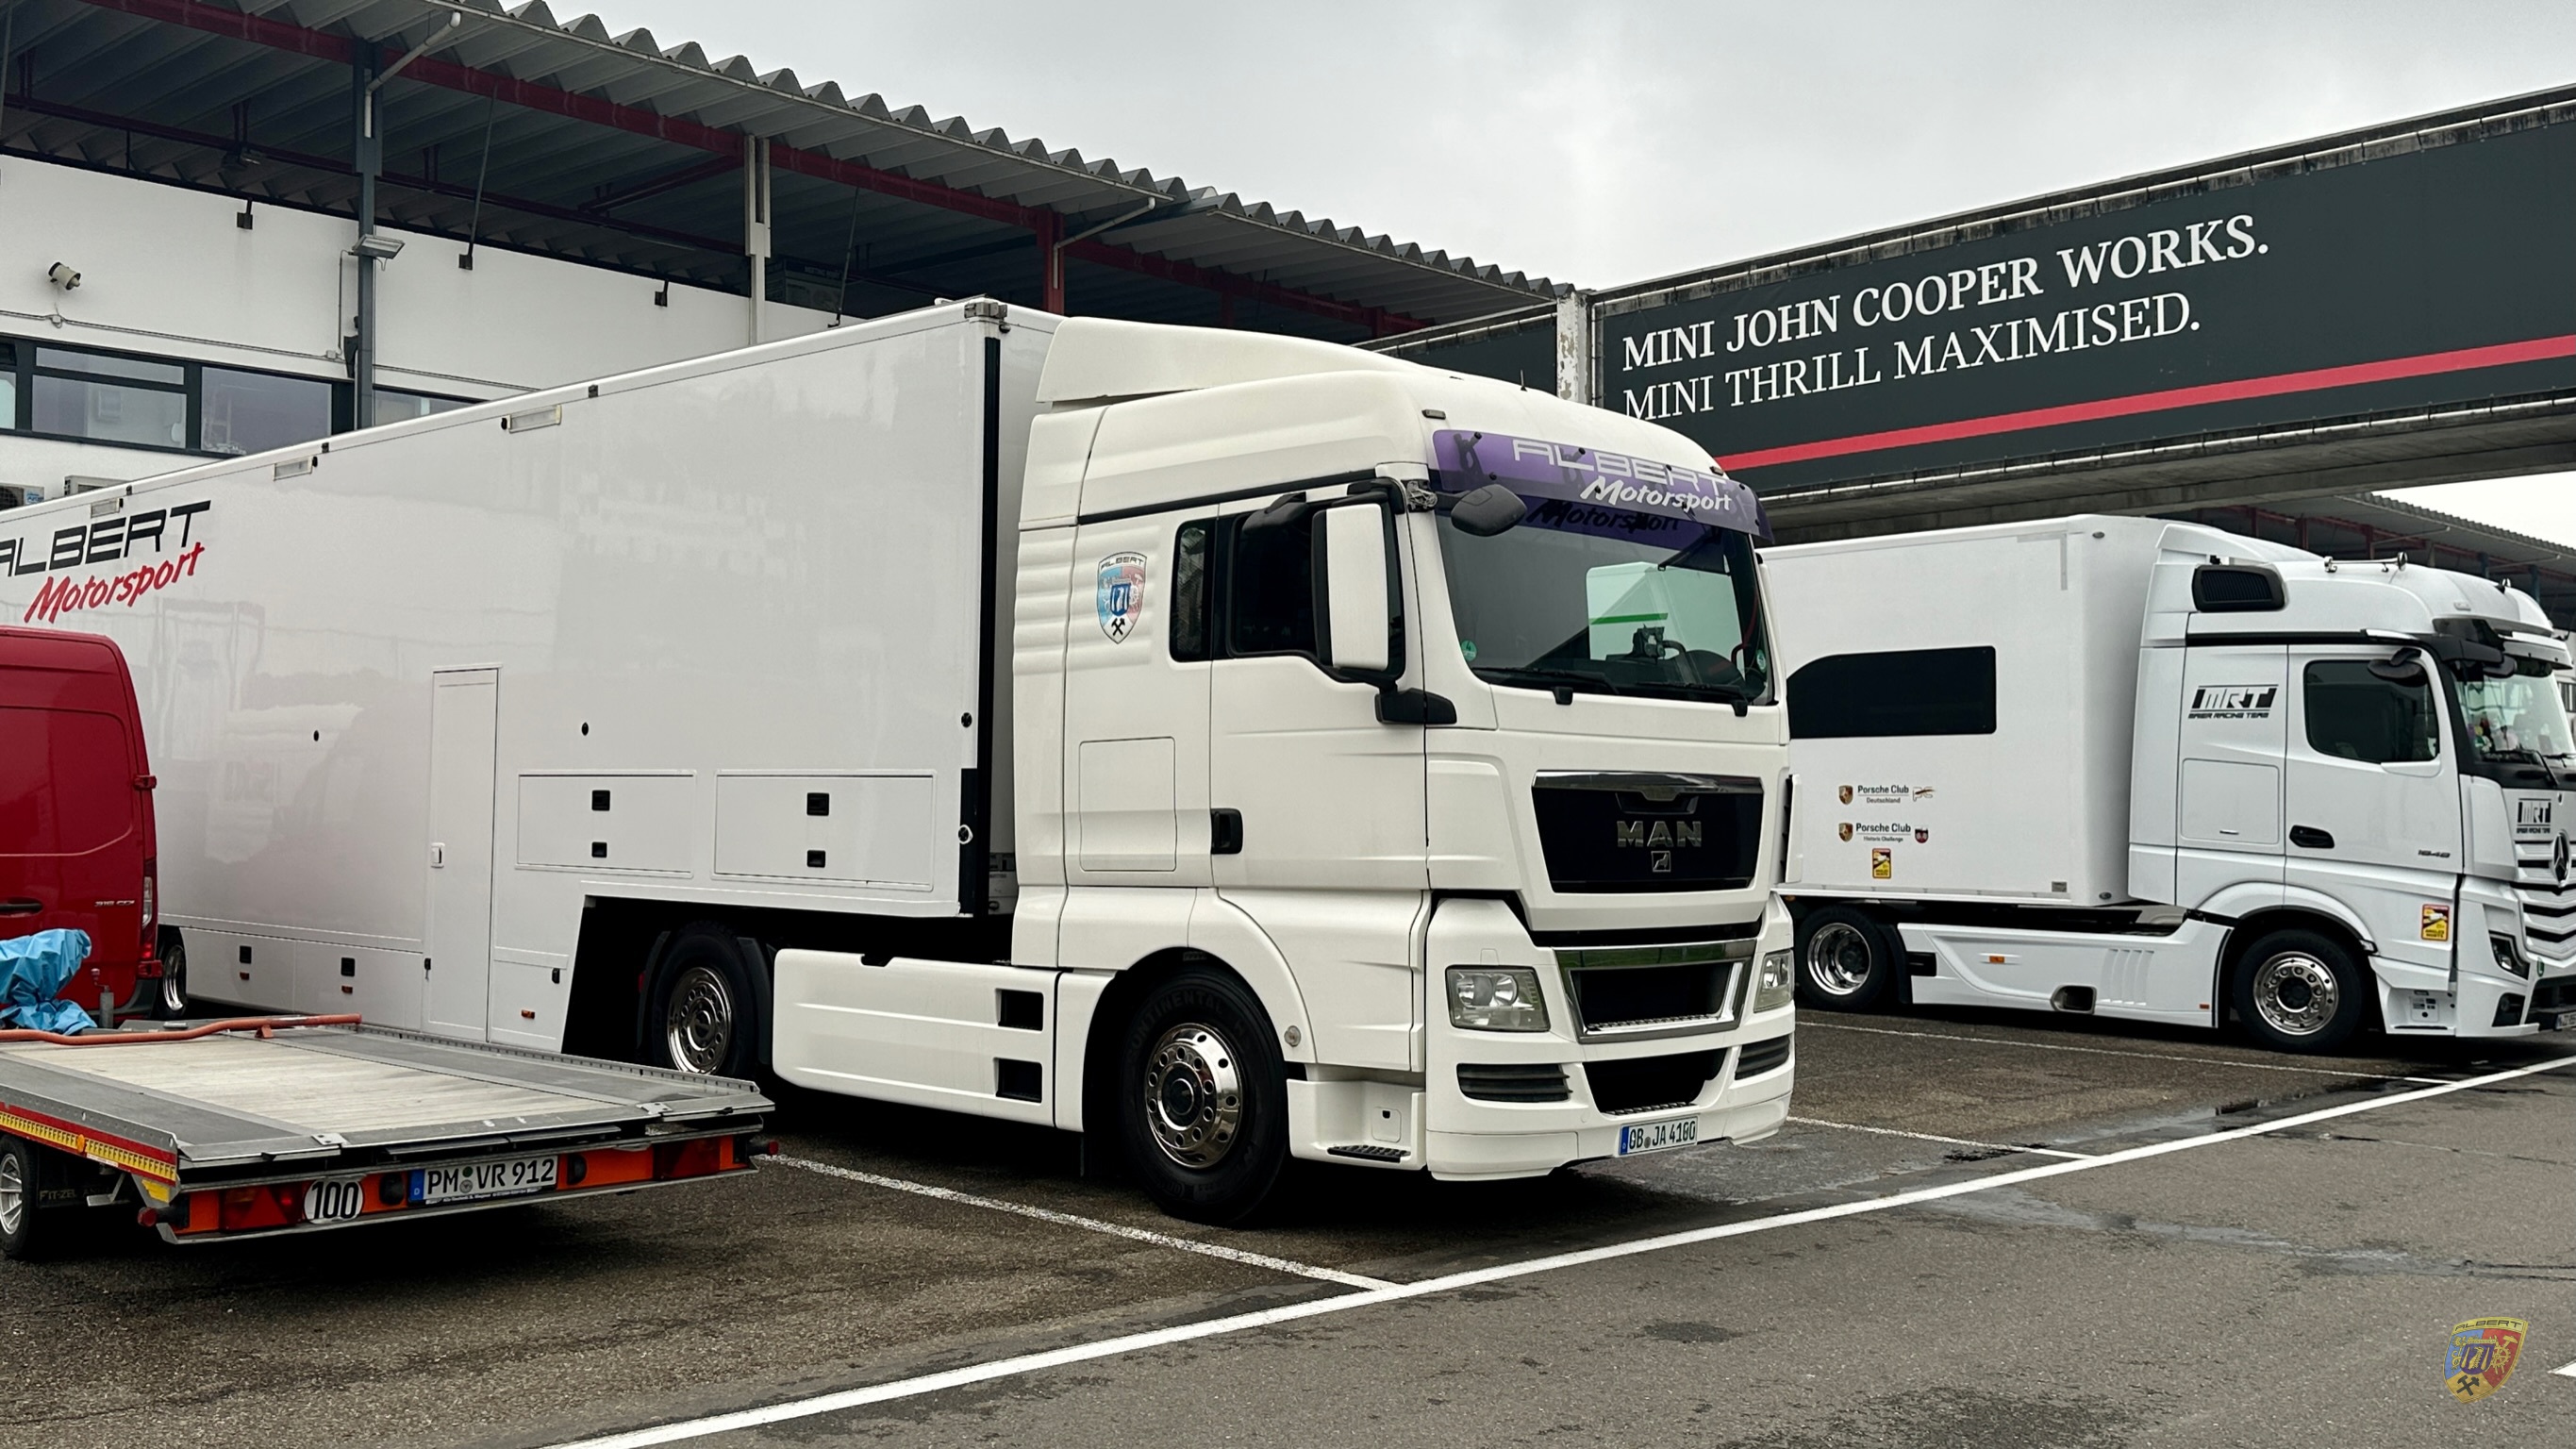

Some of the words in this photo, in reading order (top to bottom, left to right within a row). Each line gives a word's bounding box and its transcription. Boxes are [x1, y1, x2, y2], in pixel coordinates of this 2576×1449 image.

[1622, 320, 1715, 372] MINI
[1726, 294, 1841, 353] JOHN
[1852, 256, 2044, 327] COOPER
[2056, 213, 2269, 290] WORKS.
[1622, 375, 1714, 421] MINI
[1724, 346, 1881, 408] THRILL
[1893, 291, 2201, 379] MAXIMISED.
[1512, 439, 1727, 496] ALBERT
[1580, 475, 1732, 512] Motorsport
[1101, 556, 1144, 571] ALBERT
[24, 541, 205, 624] Motorsport
[2192, 688, 2277, 709] MRT
[1857, 784, 1889, 794] Porsche
[1890, 784, 1910, 794] Club
[1617, 820, 1702, 847] MAN
[1855, 823, 1889, 833] Porsche
[1891, 823, 1911, 833] Club
[1629, 1127, 1644, 1150] OB
[1653, 1124, 1666, 1146] JA
[427, 1168, 459, 1195] PM
[476, 1162, 506, 1190] VR
[512, 1158, 555, 1186] 912
[311, 1181, 359, 1219] 100
